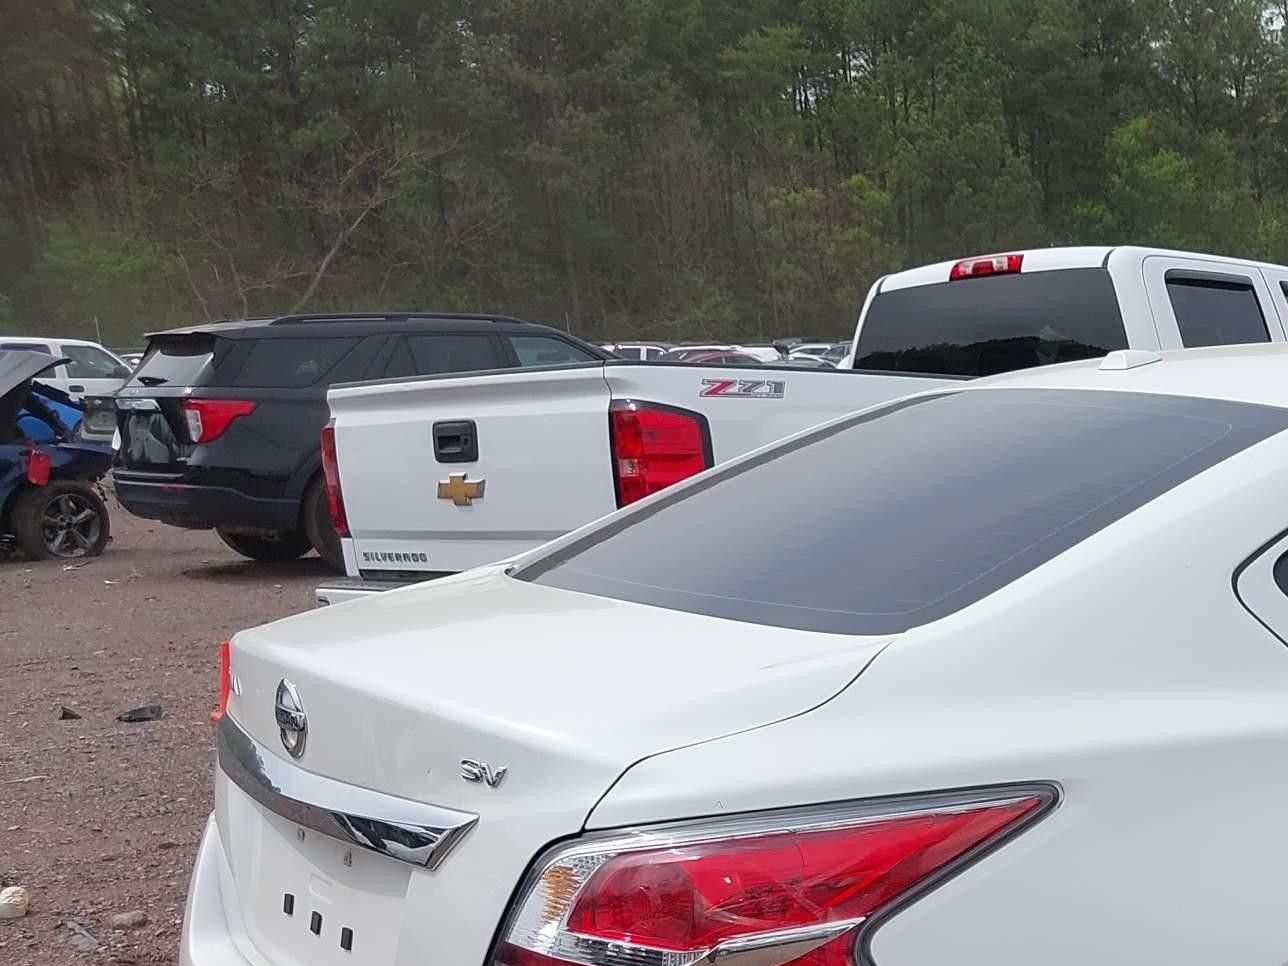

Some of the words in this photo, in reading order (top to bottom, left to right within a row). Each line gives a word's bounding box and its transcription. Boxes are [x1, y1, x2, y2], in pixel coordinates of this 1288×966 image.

[699, 378, 786, 399] Z71
[362, 551, 428, 563] SILVERADO
[461, 758, 508, 789] SV
